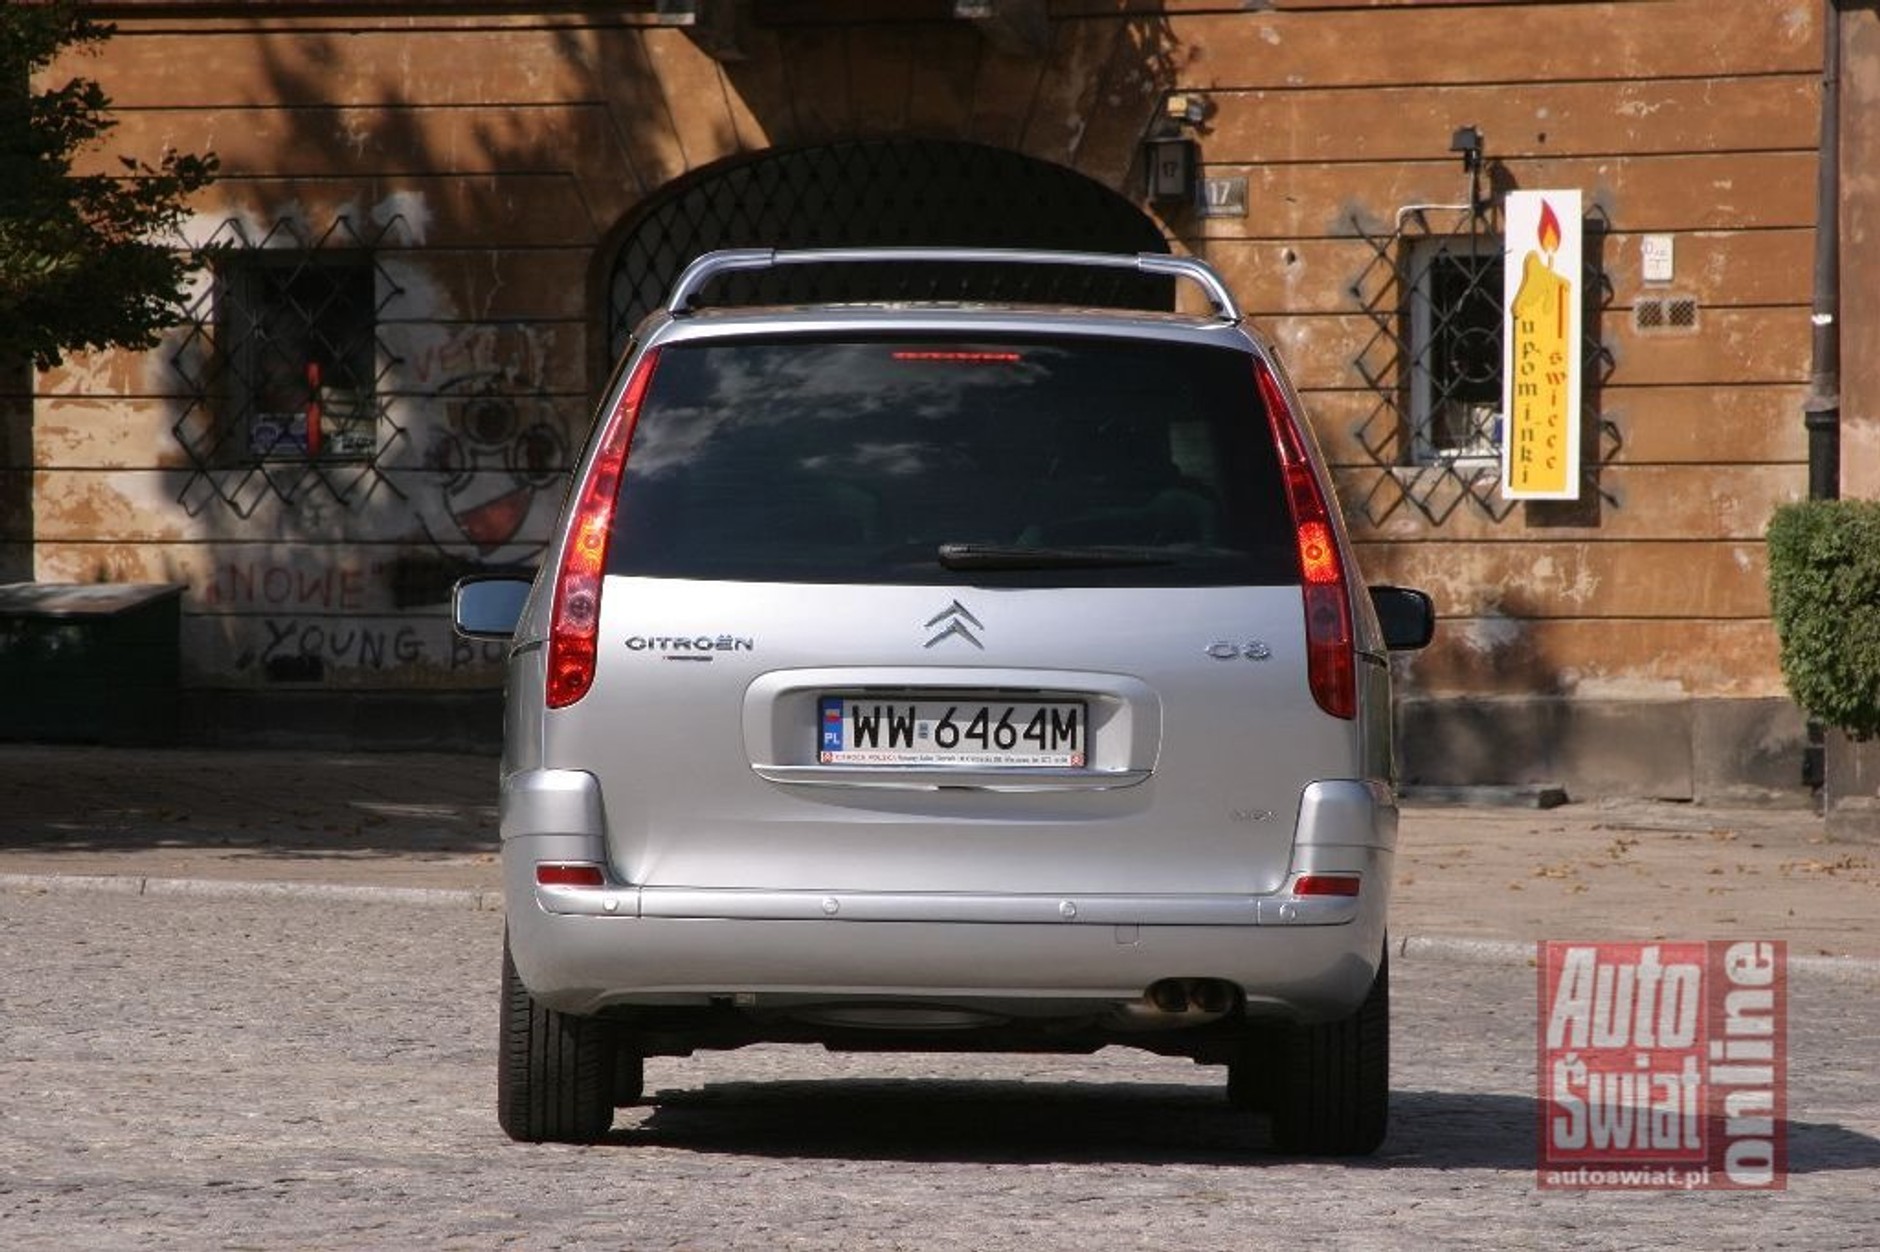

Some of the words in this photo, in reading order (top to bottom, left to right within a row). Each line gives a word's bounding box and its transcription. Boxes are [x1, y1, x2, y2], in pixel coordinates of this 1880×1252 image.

[1163, 161, 1178, 178] 17
[1210, 181, 1231, 206] 17
[1517, 319, 1540, 484] upominki
[624, 634, 754, 651] CITROËN
[824, 732, 840, 745] PL
[852, 705, 916, 749] WW
[934, 706, 1078, 751] 6464M
